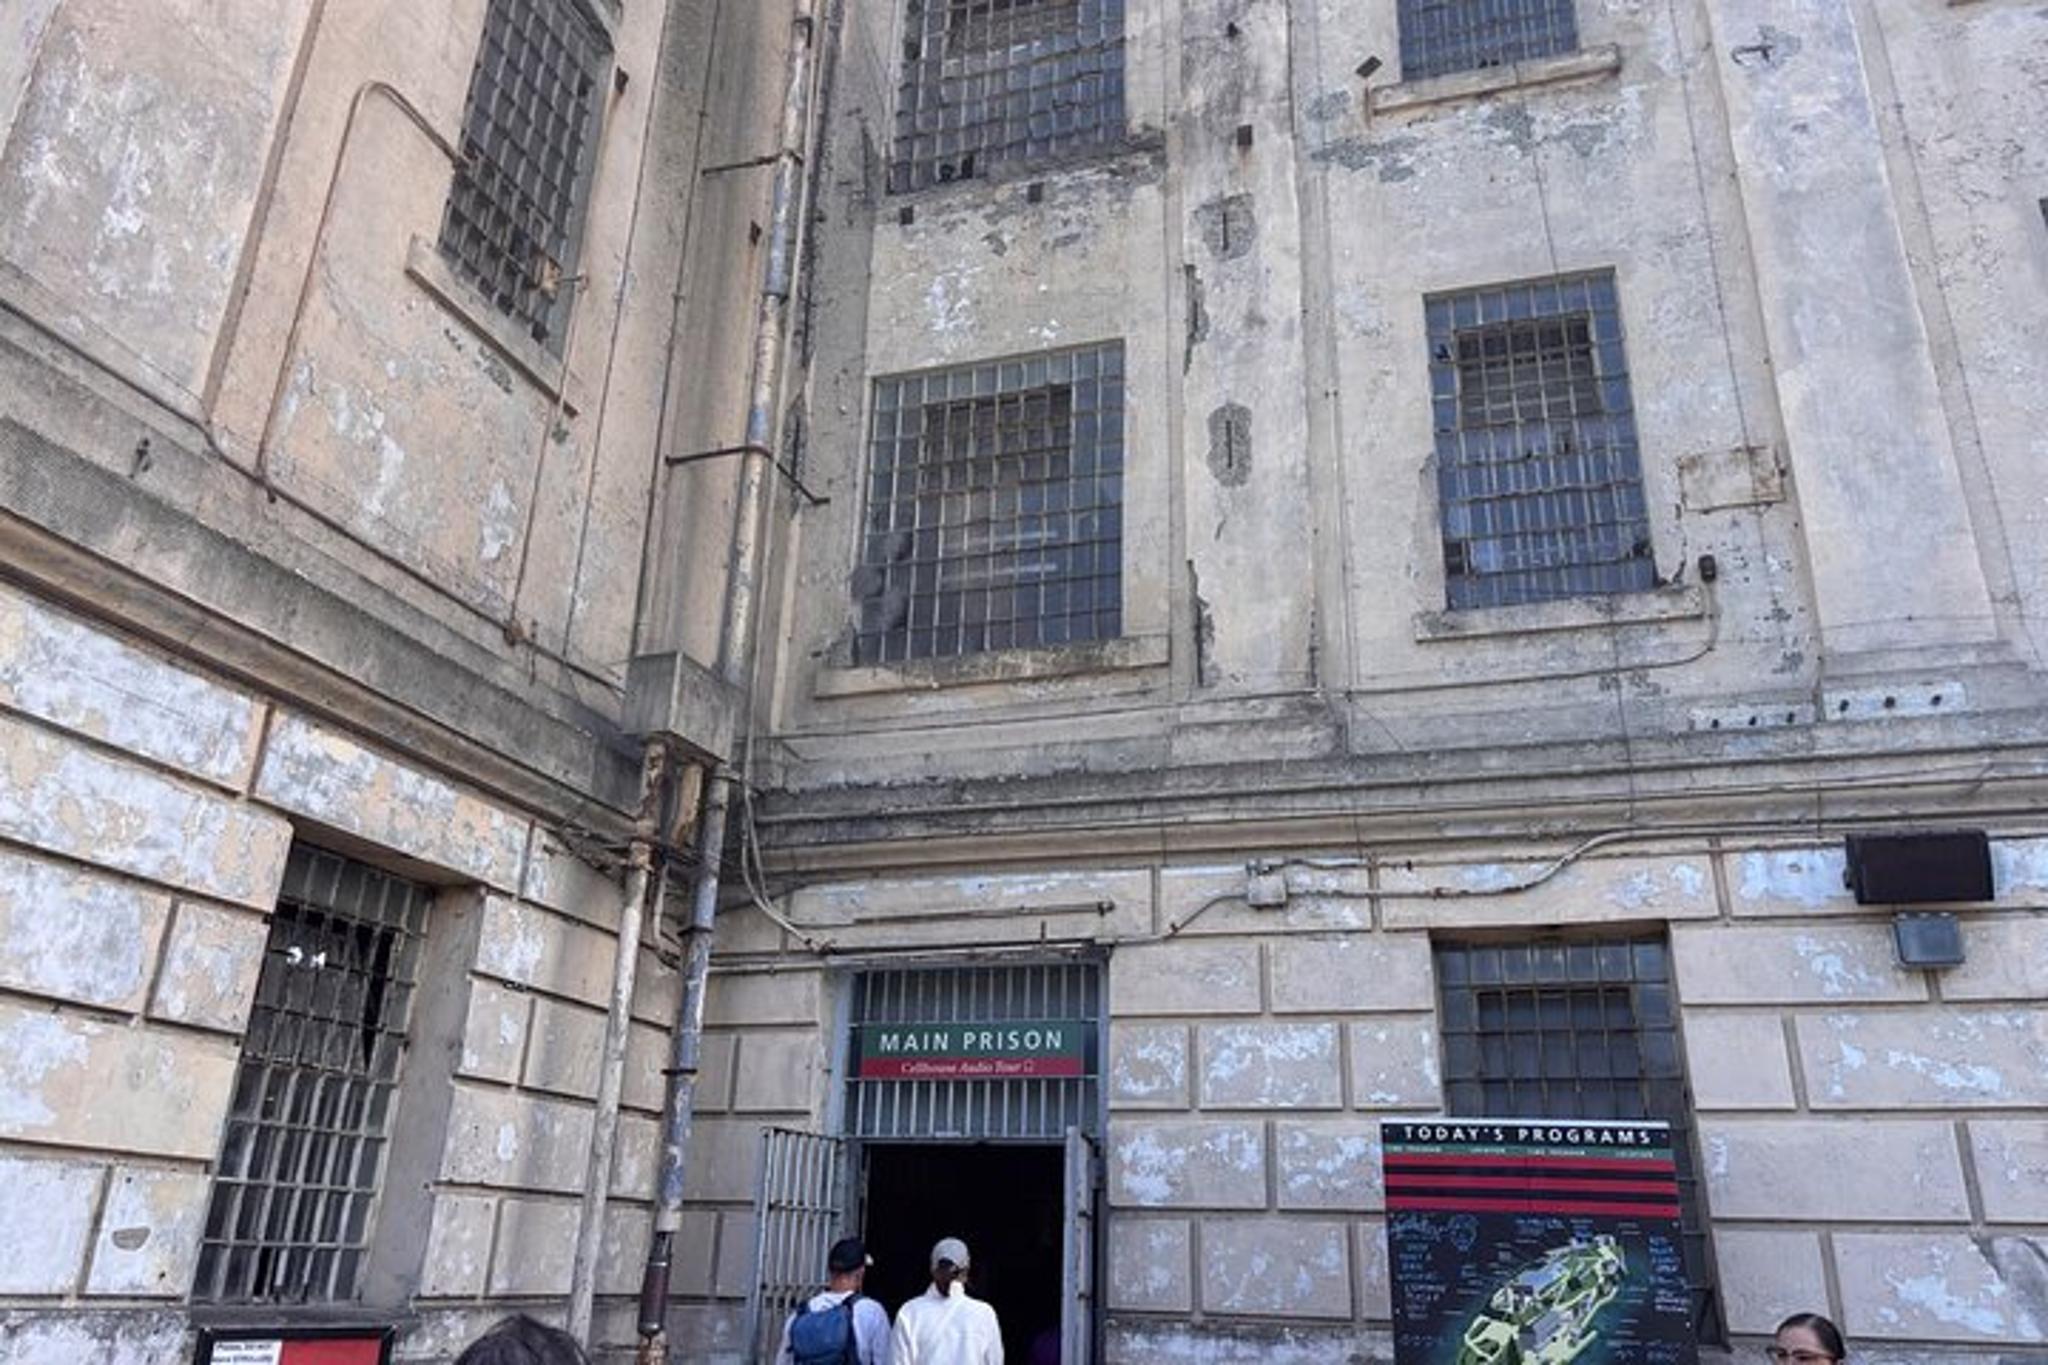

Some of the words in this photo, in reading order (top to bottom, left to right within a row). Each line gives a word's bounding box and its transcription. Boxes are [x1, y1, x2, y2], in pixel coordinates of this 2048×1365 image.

[879, 1033, 949, 1051] MAIN
[963, 1030, 1063, 1050] PRISON
[901, 1062, 956, 1073] Cellhouse
[958, 1061, 993, 1073] Audio
[994, 1060, 1021, 1072] Tour
[1403, 1126, 1504, 1142] TODAY'S
[1518, 1128, 1652, 1144] PROGRAMS
